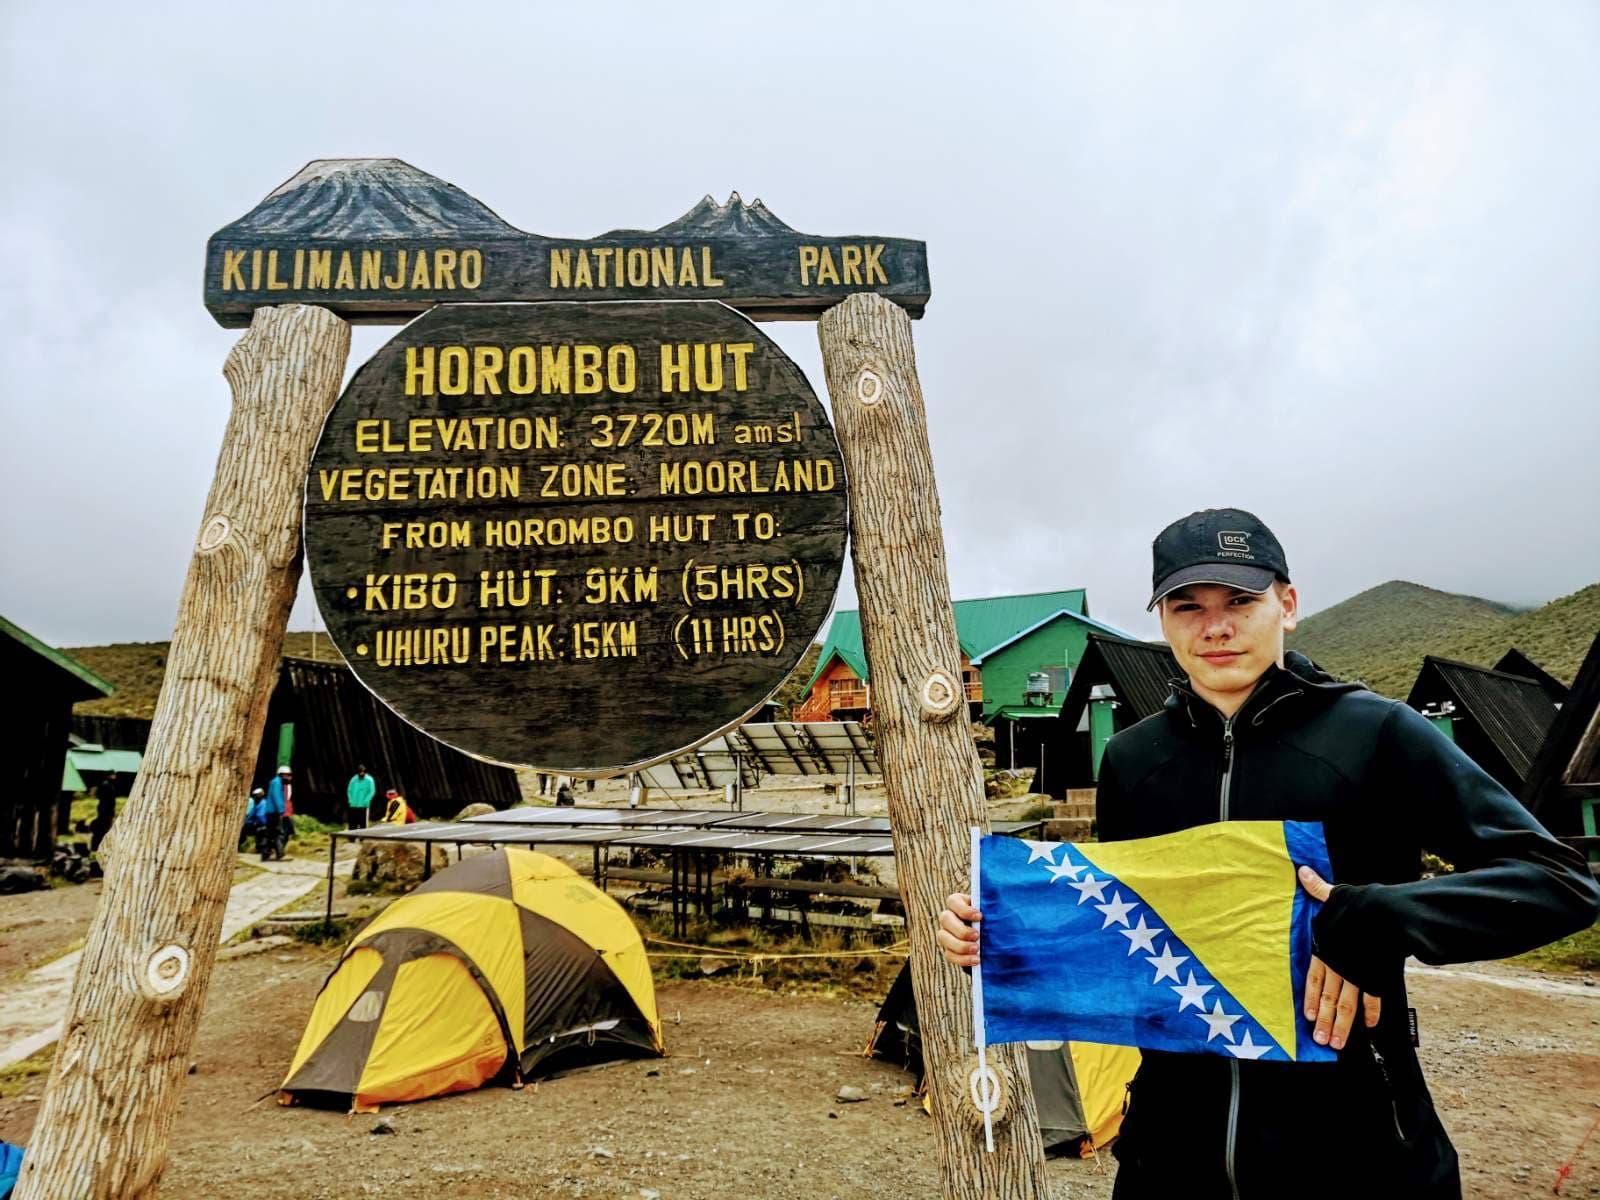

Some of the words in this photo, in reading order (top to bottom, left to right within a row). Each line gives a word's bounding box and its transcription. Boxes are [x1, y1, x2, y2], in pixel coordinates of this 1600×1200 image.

[222, 249, 482, 291] KILIMANJARO
[550, 246, 724, 289] NATIONAL
[800, 244, 889, 286] PARK
[404, 343, 636, 396] HOROMBO
[661, 342, 754, 393] HUT
[356, 416, 565, 453] ELEVATION:
[591, 413, 715, 447] 3720M
[734, 411, 802, 444] amsl
[319, 466, 521, 501] VEGETATION
[540, 463, 637, 497] ZONE:
[659, 459, 835, 495] MOORLAND
[382, 520, 470, 549] FROM
[486, 516, 634, 547] HOROMBO
[649, 514, 716, 543] HUT
[732, 512, 782, 540] TO:
[365, 573, 457, 611] KIBO
[480, 569, 563, 608] HUT:
[585, 566, 658, 604] 9KM
[681, 558, 805, 606] (5HRS)
[376, 626, 470, 667] UHURU
[480, 624, 564, 663] PEAK:
[572, 620, 638, 659] 15KM
[673, 614, 713, 660] (11
[722, 609, 785, 656] HRS)
